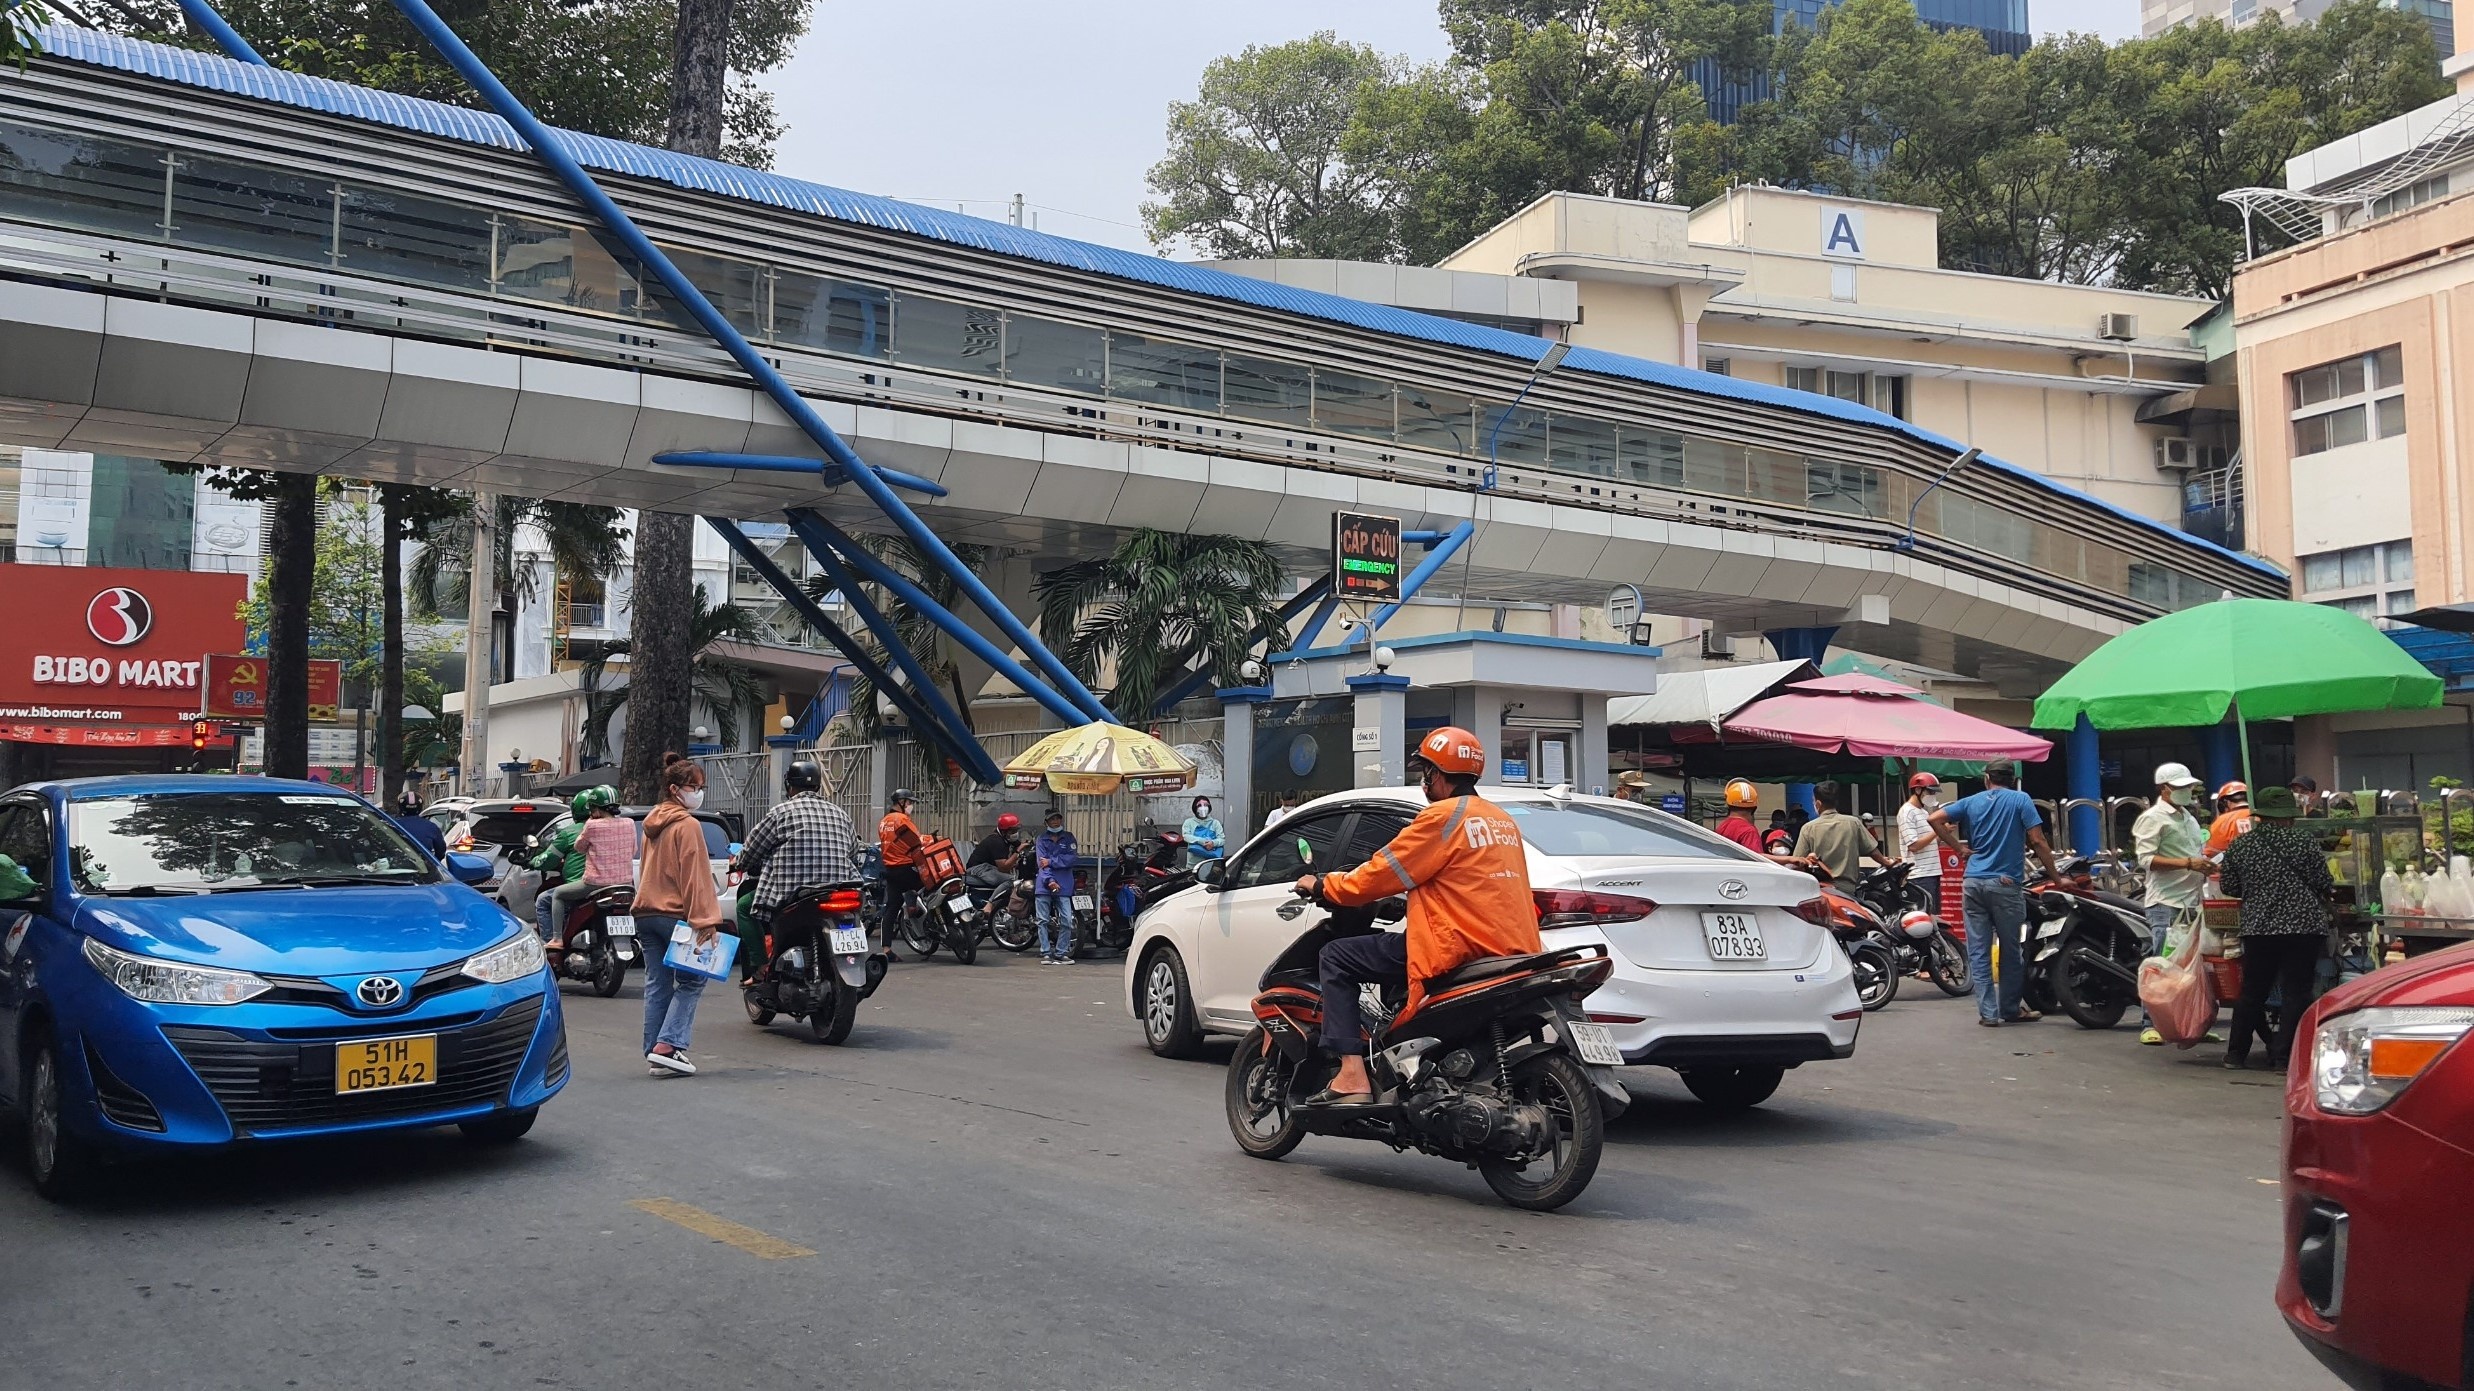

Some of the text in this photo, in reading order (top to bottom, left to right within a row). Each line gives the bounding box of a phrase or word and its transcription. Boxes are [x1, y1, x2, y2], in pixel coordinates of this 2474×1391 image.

[1827, 212, 1861, 253] A
[1343, 521, 1396, 558] CẤP CỨU
[1343, 558, 1396, 575] EMERGENCY
[33, 655, 201, 687] BIBO MART
[233, 691, 256, 704] 92
[1492, 829, 1519, 848] Food
[835, 930, 860, 941] 71-C4
[1716, 914, 1748, 936] 83A
[835, 940, 866, 952] 426.94
[1711, 936, 1764, 957] 078.93
[366, 1040, 408, 1064] 51H
[1581, 1043, 1620, 1062] 449.98
[347, 1062, 425, 1090] 053.42
